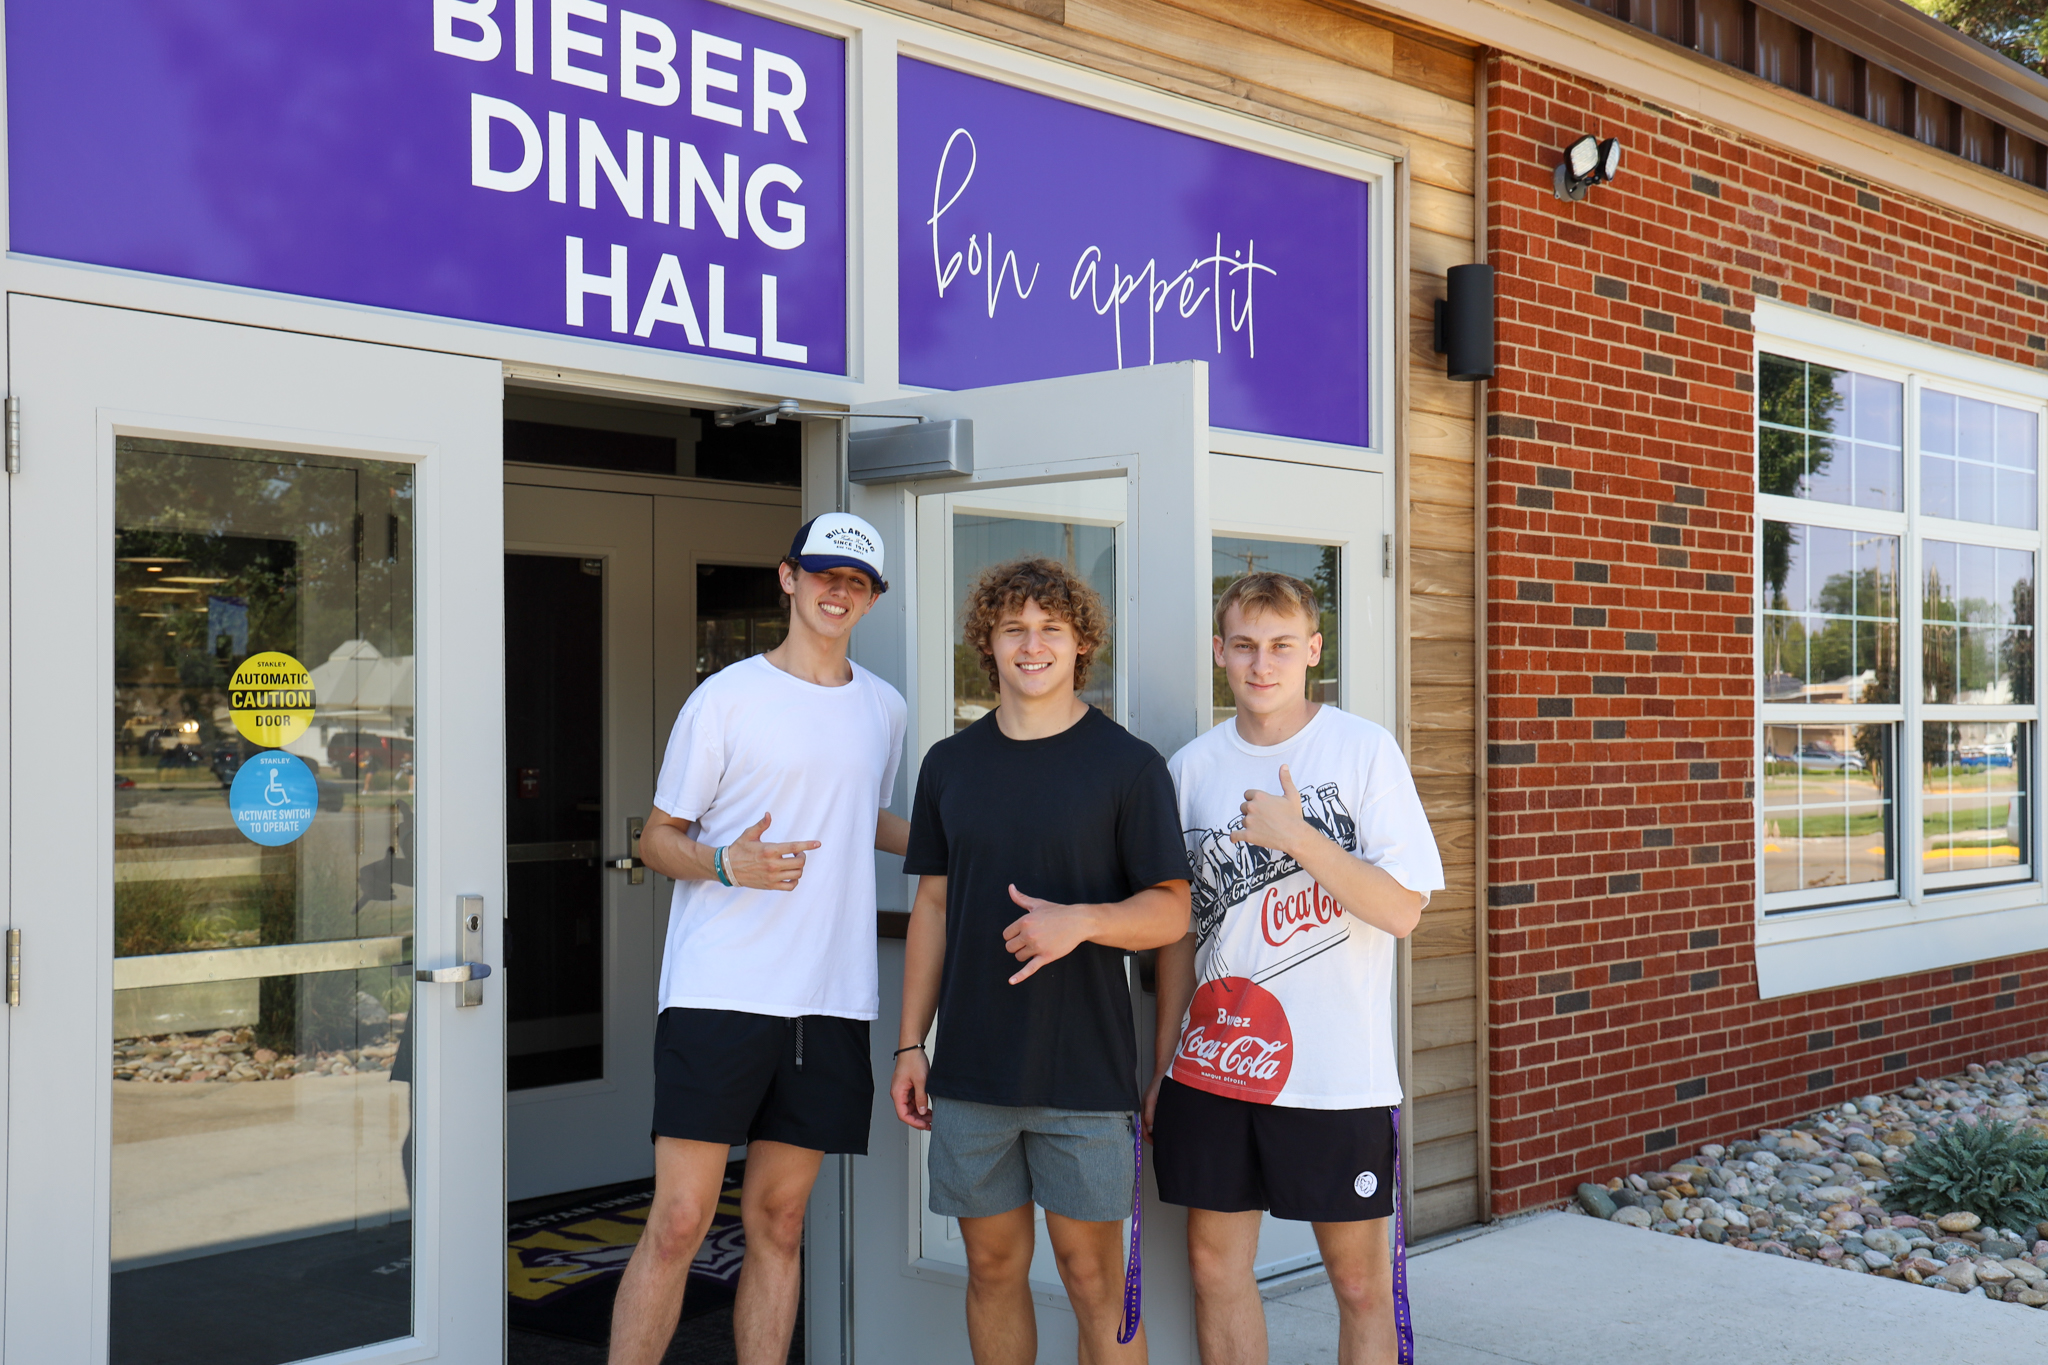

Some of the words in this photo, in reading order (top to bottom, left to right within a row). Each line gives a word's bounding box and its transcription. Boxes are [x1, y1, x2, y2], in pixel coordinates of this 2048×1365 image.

[433, 0, 808, 144] BIEBER
[471, 93, 806, 250] DINING
[927, 128, 1040, 318] bon
[1070, 232, 1277, 370] appétit
[566, 235, 808, 364] HALL
[825, 528, 875, 552] BILLABONG
[235, 672, 309, 685] AUTOMATIC
[231, 690, 311, 709] CAUTION
[255, 714, 291, 727] DOOR
[260, 757, 291, 765] STANLEY
[238, 809, 278, 822] ACTIVATE
[278, 808, 311, 820] SWITCH
[250, 822, 262, 833] TO
[263, 820, 300, 833] OPERATE
[1179, 1026, 1288, 1080] Coca-Cola
